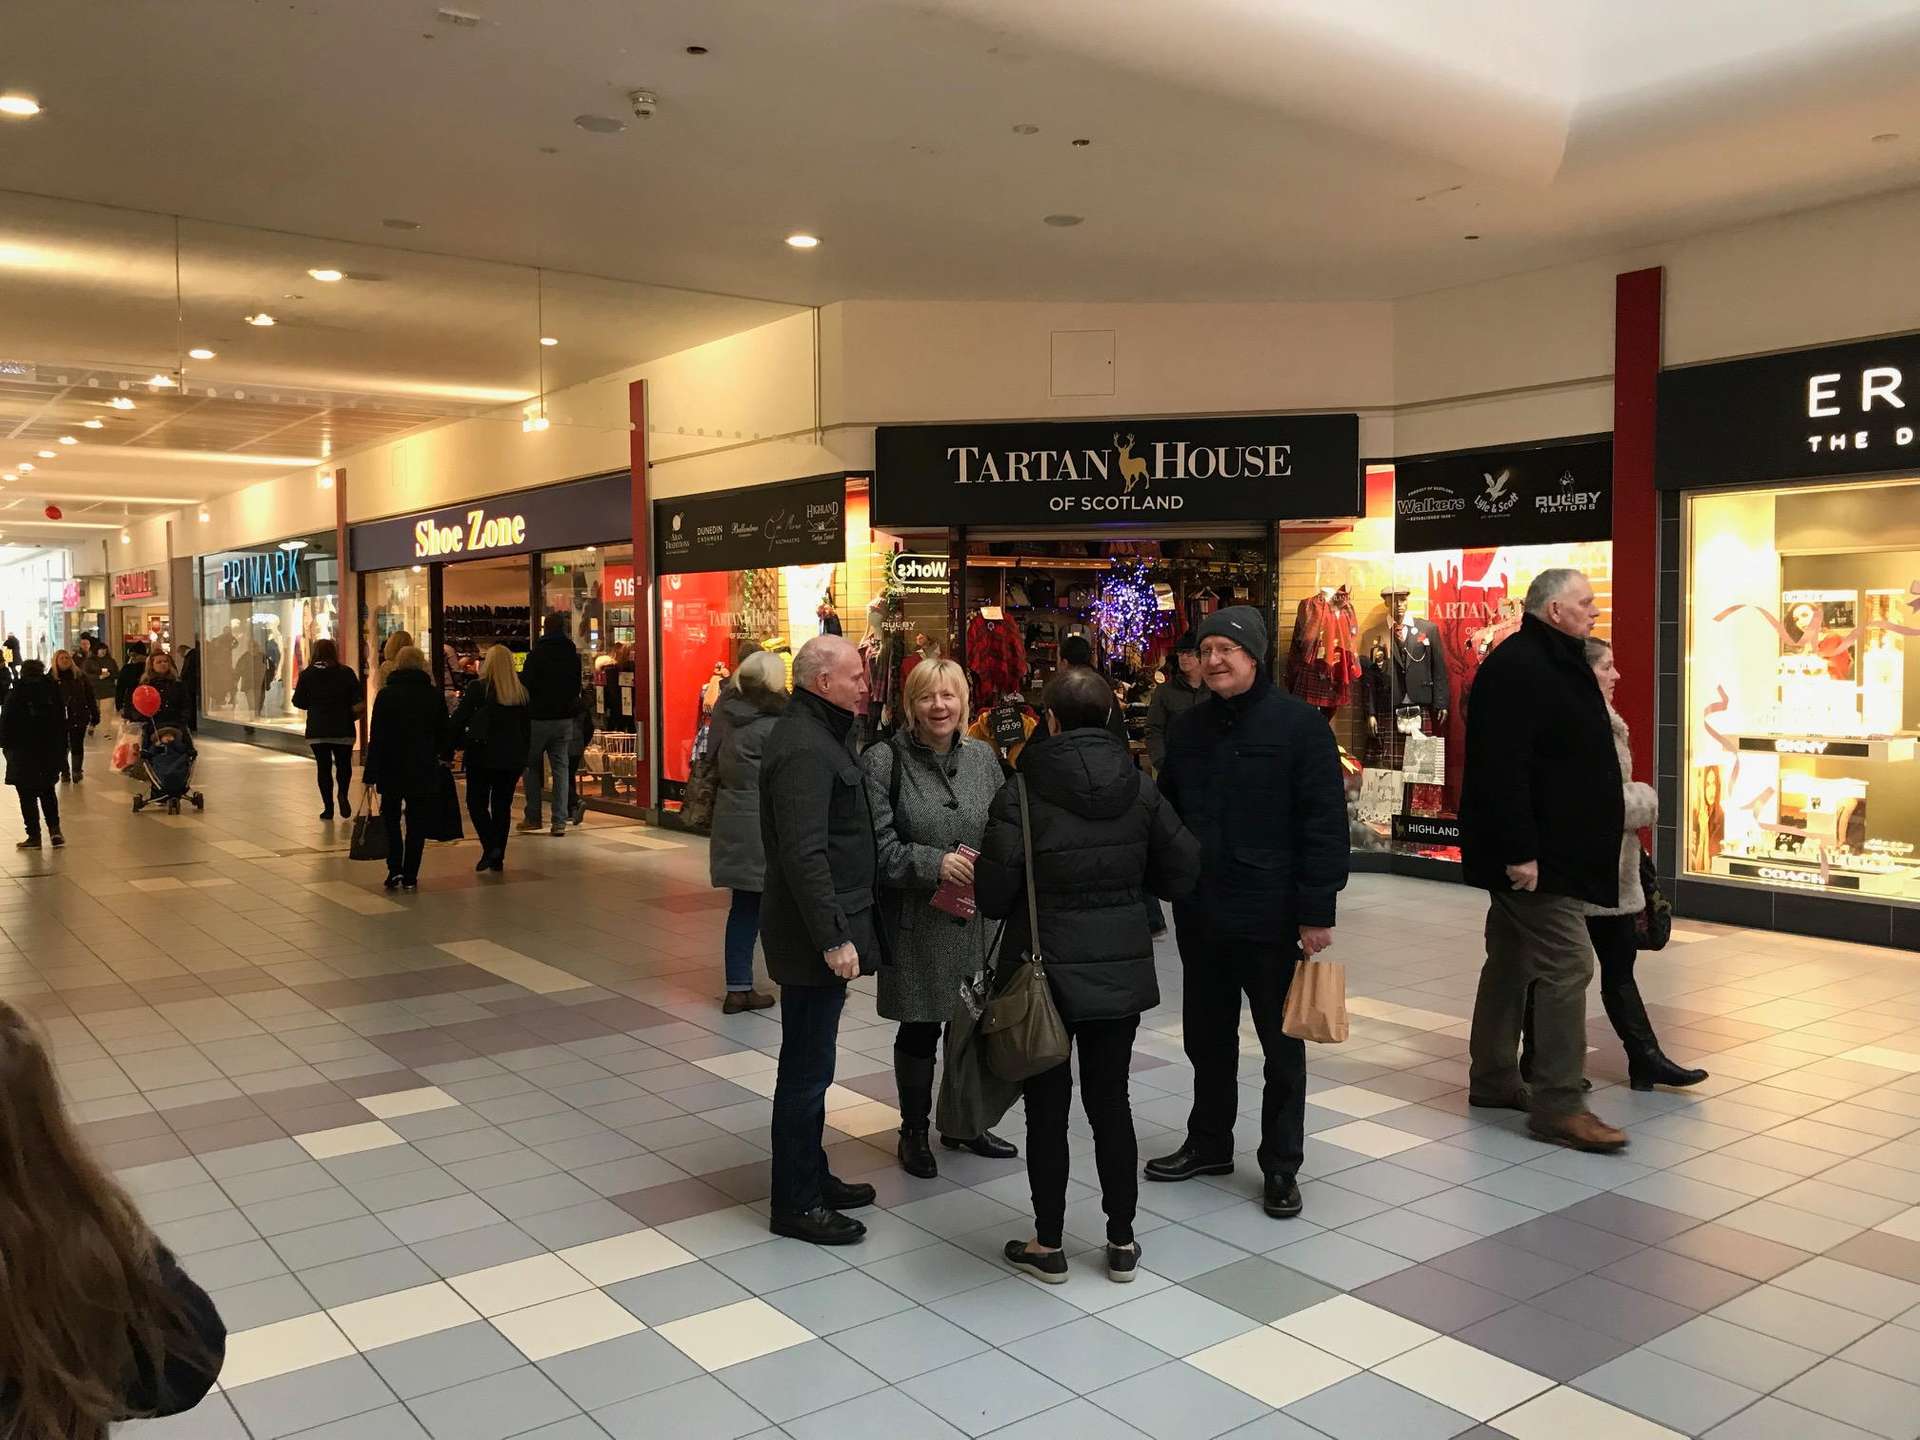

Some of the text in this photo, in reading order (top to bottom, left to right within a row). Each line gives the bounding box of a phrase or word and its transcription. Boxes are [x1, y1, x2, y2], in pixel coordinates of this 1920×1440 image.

[1808, 431, 1869, 453] THE
[947, 441, 1293, 484] TARTAN HOUSE
[1049, 496, 1184, 512] OF SCOTLAND
[1397, 497, 1465, 515] Walkers
[1474, 492, 1519, 513] Lyle & Scott
[1535, 491, 1601, 508] RUGBY
[1540, 503, 1596, 514] NATIONS
[415, 510, 526, 558] Shoe Zone
[697, 525, 723, 536] DUNEDIN
[223, 548, 301, 600] PRIMARK
[1430, 600, 1499, 620] ARTAN
[996, 721, 1022, 733] £49.99
[1408, 823, 1460, 837] HIGHLAND
[1758, 867, 1826, 885] COACH
